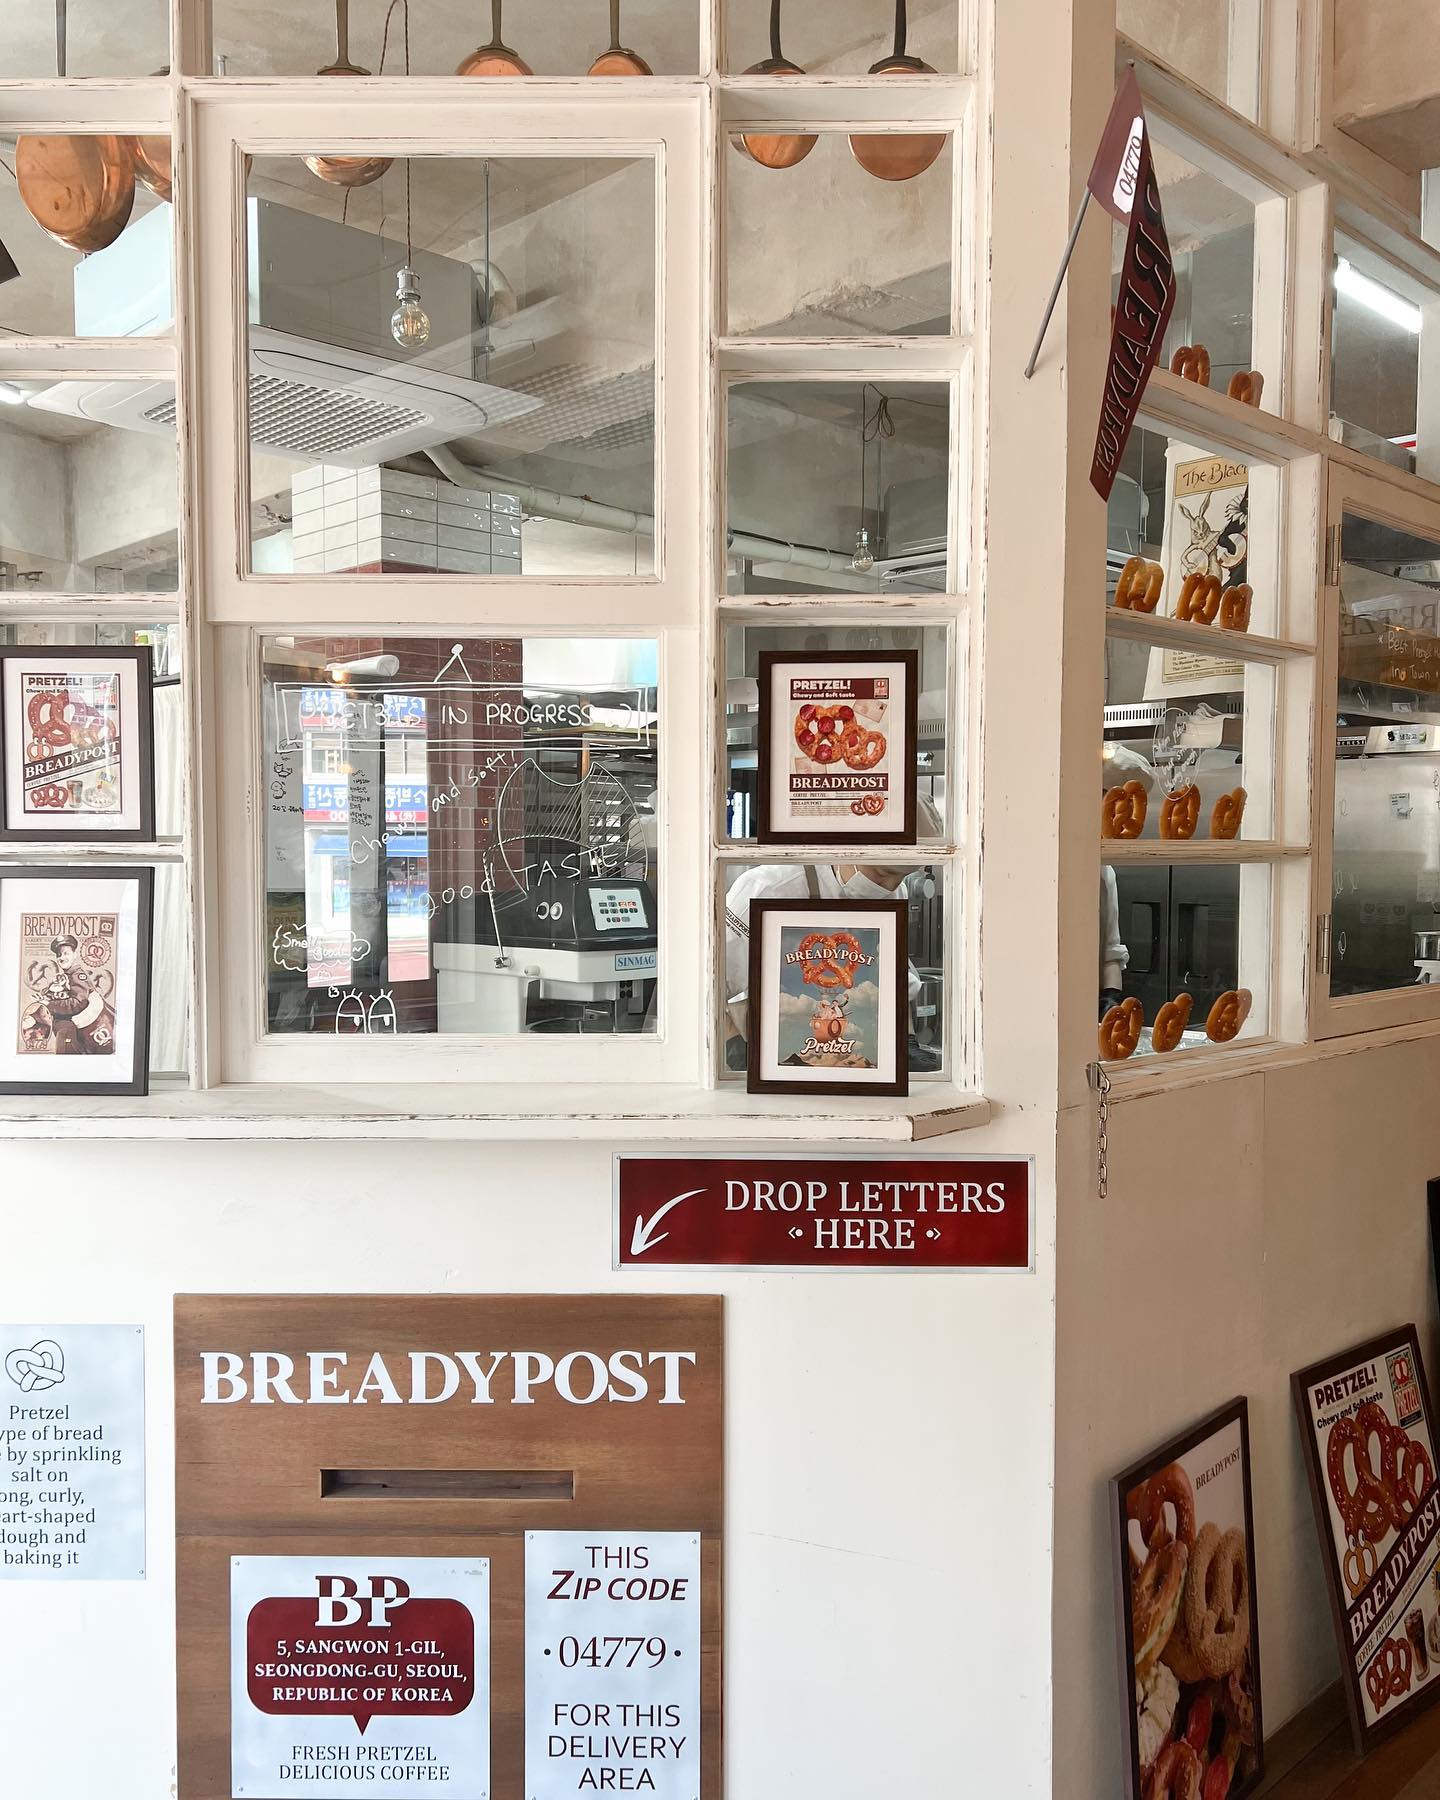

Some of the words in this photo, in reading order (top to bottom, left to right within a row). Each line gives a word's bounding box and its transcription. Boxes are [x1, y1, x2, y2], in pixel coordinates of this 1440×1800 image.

[1183, 467, 1206, 488] The
[1388, 631, 1408, 653] Best
[28, 677, 82, 686] PRETZEL!
[793, 680, 851, 690] PRETZEL!
[442, 705, 467, 725] IN
[486, 703, 595, 726] PROGRESS
[25, 741, 119, 779] BREADYPOST
[792, 776, 886, 789] BREADYPOST
[513, 838, 632, 891] TASTE!
[24, 916, 98, 936] BREADYPOST
[617, 954, 655, 969] SINMAG
[785, 949, 875, 967] BREADYPOST
[800, 1037, 856, 1055] Pretzel
[724, 1180, 828, 1212] DROP
[839, 1181, 1006, 1213] LETTERS
[813, 1218, 916, 1250] HERE
[200, 1350, 696, 1404] BREADYPOST
[1314, 1364, 1378, 1410] PRETZEL!
[10, 1405, 70, 1420] Pretzel
[1317, 1412, 1340, 1429] Chewy
[1340, 1405, 1352, 1418] and
[32, 1426, 49, 1441] of
[54, 1425, 103, 1441] bread
[7, 1447, 28, 1465] by
[32, 1446, 122, 1465] sprinkling
[11, 1467, 42, 1482] salt
[48, 1471, 69, 1482] on
[1195, 1446, 1241, 1490] BREADYPOST
[38, 1487, 85, 1506] curly,
[54, 1529, 86, 1544] and
[4, 1550, 62, 1568] baking
[67, 1550, 80, 1565] it
[585, 1546, 649, 1569] THIS
[1350, 1489, 1440, 1645] BREADYPOST
[547, 1570, 602, 1600] ZIP
[608, 1577, 688, 1601] CODE
[314, 1575, 410, 1627] BP
[276, 1640, 292, 1658] 5,
[295, 1640, 389, 1655] SANGWON
[395, 1640, 446, 1658] 1-GIL,
[559, 1636, 667, 1669] 04779
[255, 1664, 403, 1682] SEONGDONG-GU,
[406, 1664, 468, 1682] SEOUL,
[272, 1687, 359, 1702] REPUBLIC
[362, 1687, 386, 1702] OF
[391, 1688, 454, 1702] KOREA
[554, 1703, 611, 1727] FOR
[616, 1704, 681, 1728] THIS
[292, 1745, 350, 1761] FRESH
[356, 1746, 437, 1761] PRETZEL
[548, 1735, 687, 1759] DELIVERY
[279, 1765, 376, 1780] DELICIOUS
[380, 1765, 450, 1781] COFFEE
[578, 1768, 656, 1790] AREA
